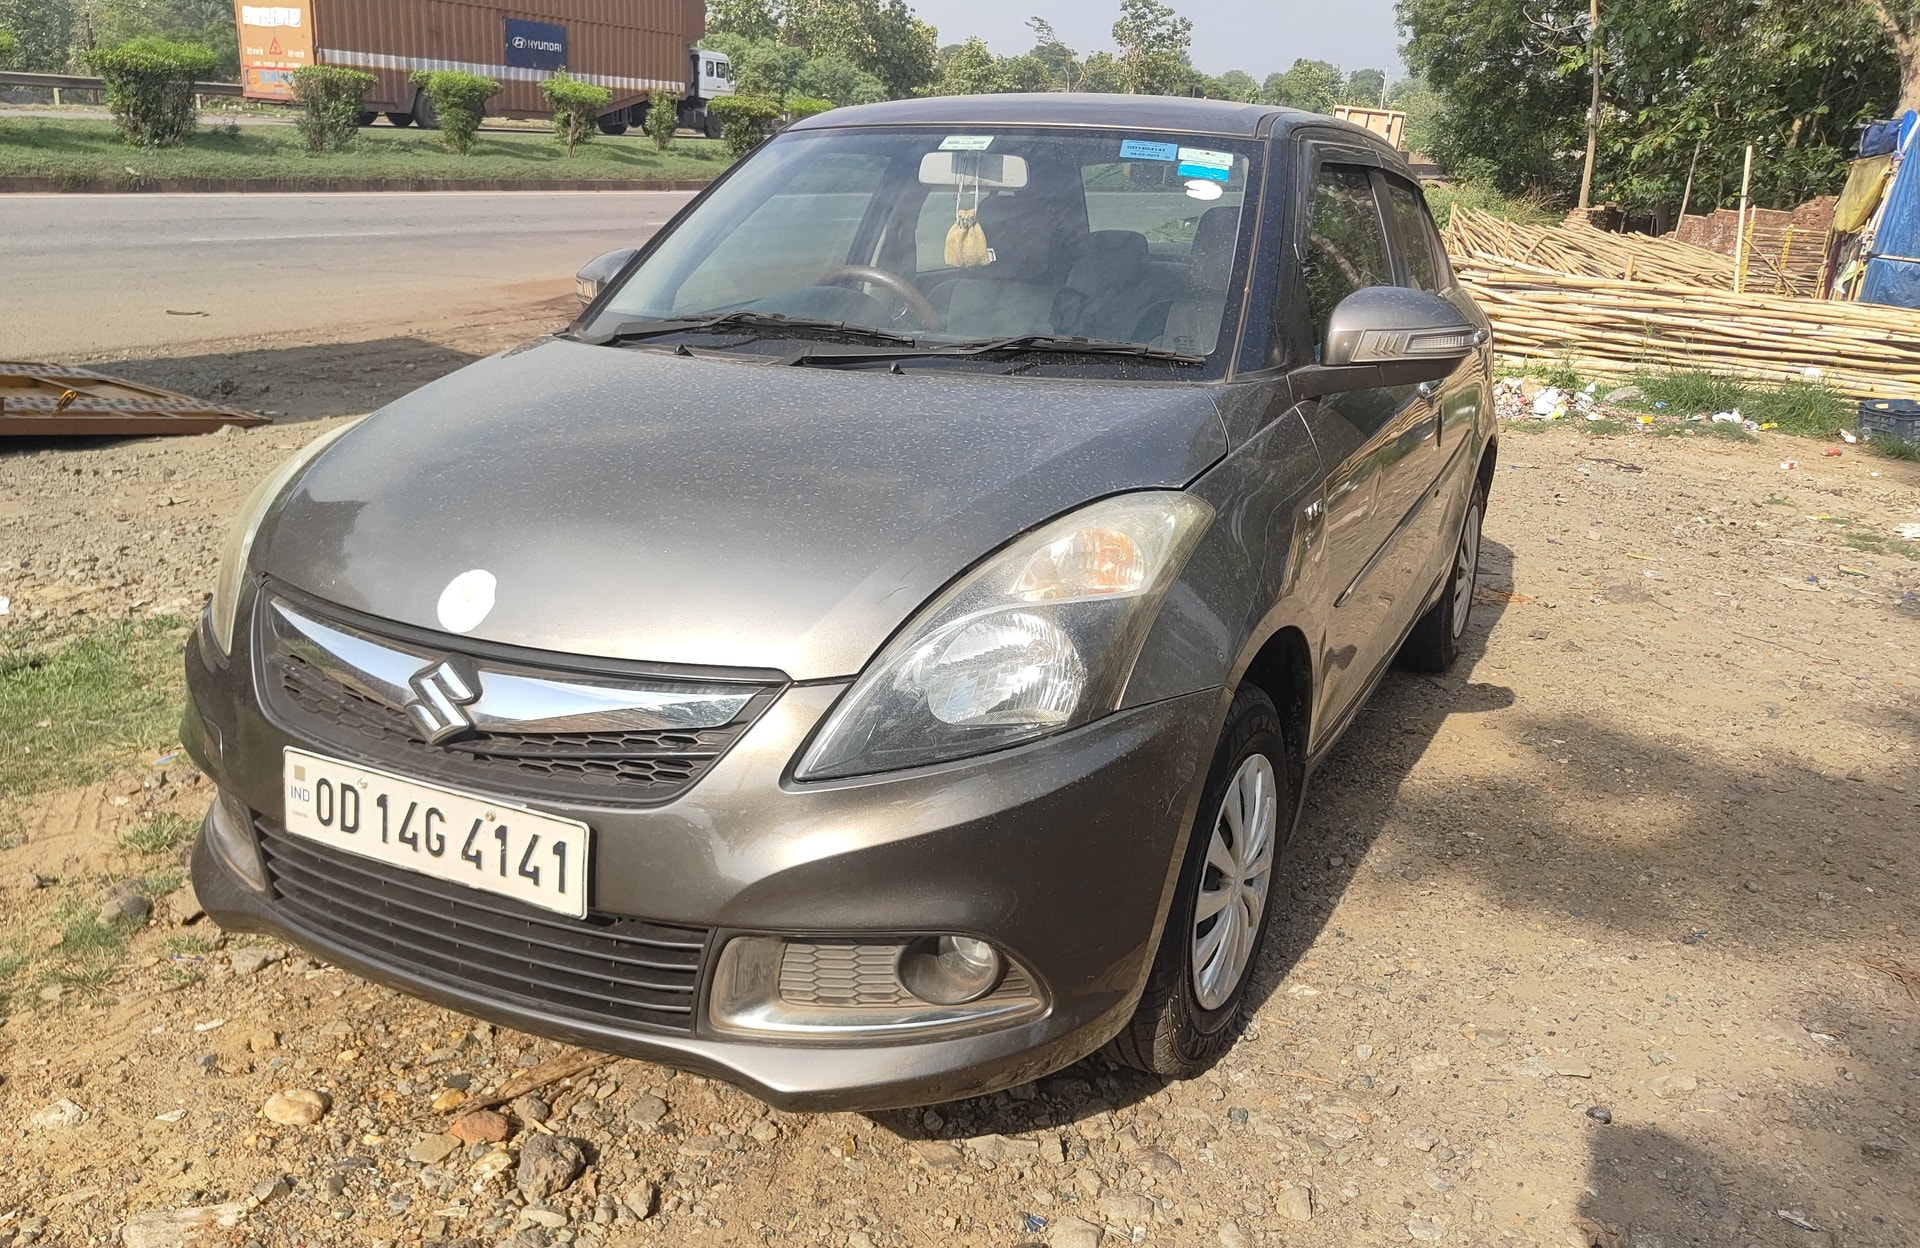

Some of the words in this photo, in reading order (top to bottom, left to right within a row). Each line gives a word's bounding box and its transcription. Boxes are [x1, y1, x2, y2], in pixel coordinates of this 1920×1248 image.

[527, 39, 562, 52] HYUNDAI
[290, 785, 310, 802] IND
[316, 778, 360, 833] OD
[376, 793, 446, 858] 14G
[461, 818, 567, 894] 4141
